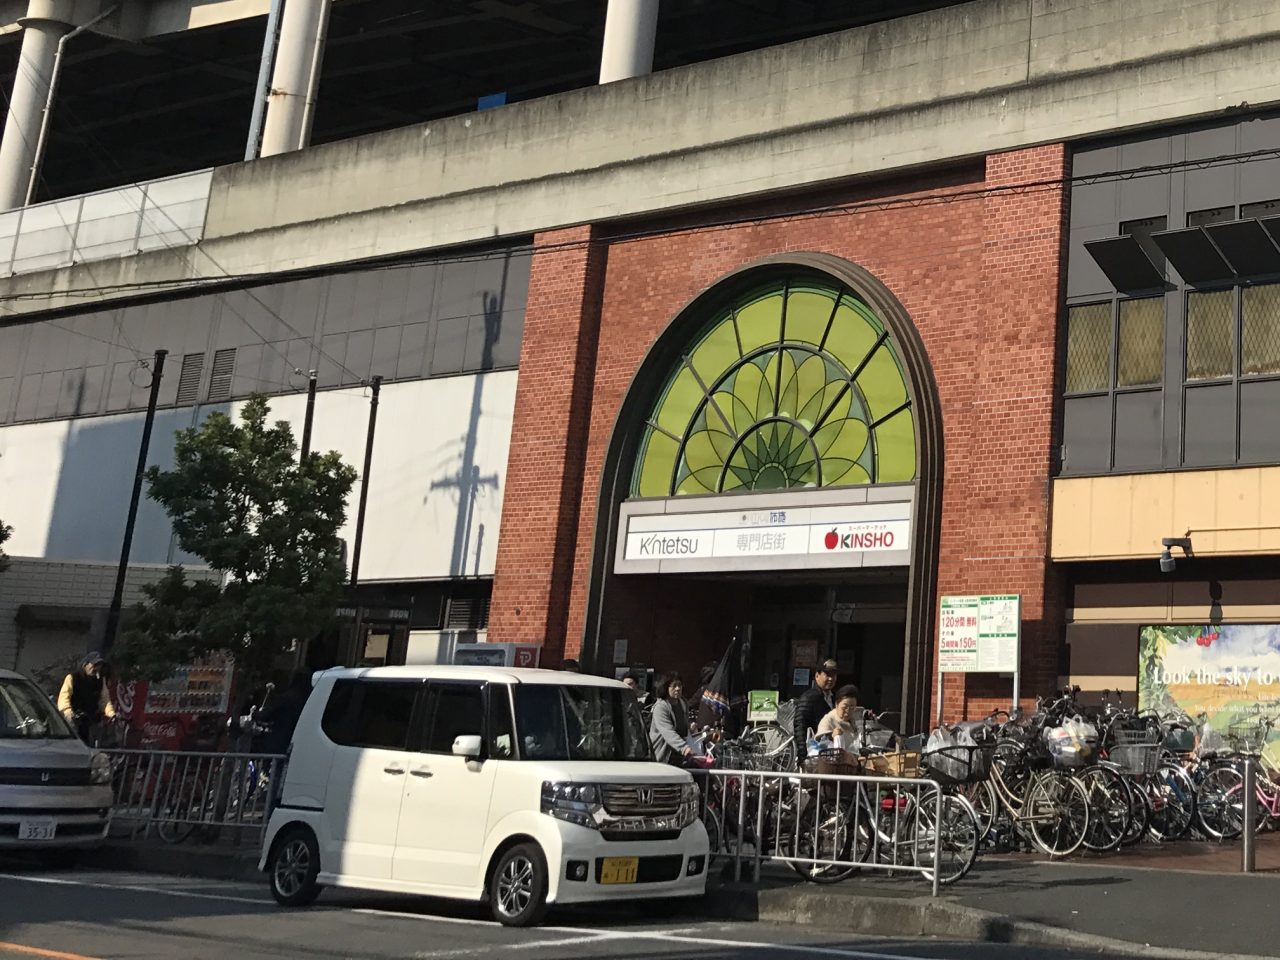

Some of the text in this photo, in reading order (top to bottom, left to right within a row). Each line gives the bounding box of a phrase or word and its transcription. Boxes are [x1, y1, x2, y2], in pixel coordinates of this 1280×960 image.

[736, 532, 787, 552] 専門店街
[841, 531, 895, 549] KINSHO
[1153, 665, 1191, 685] Look
[1196, 665, 1220, 685] the
[1226, 665, 1252, 691] sky
[1258, 669, 1274, 686] to
[1228, 704, 1244, 713] what
[1246, 706, 1258, 715] you
